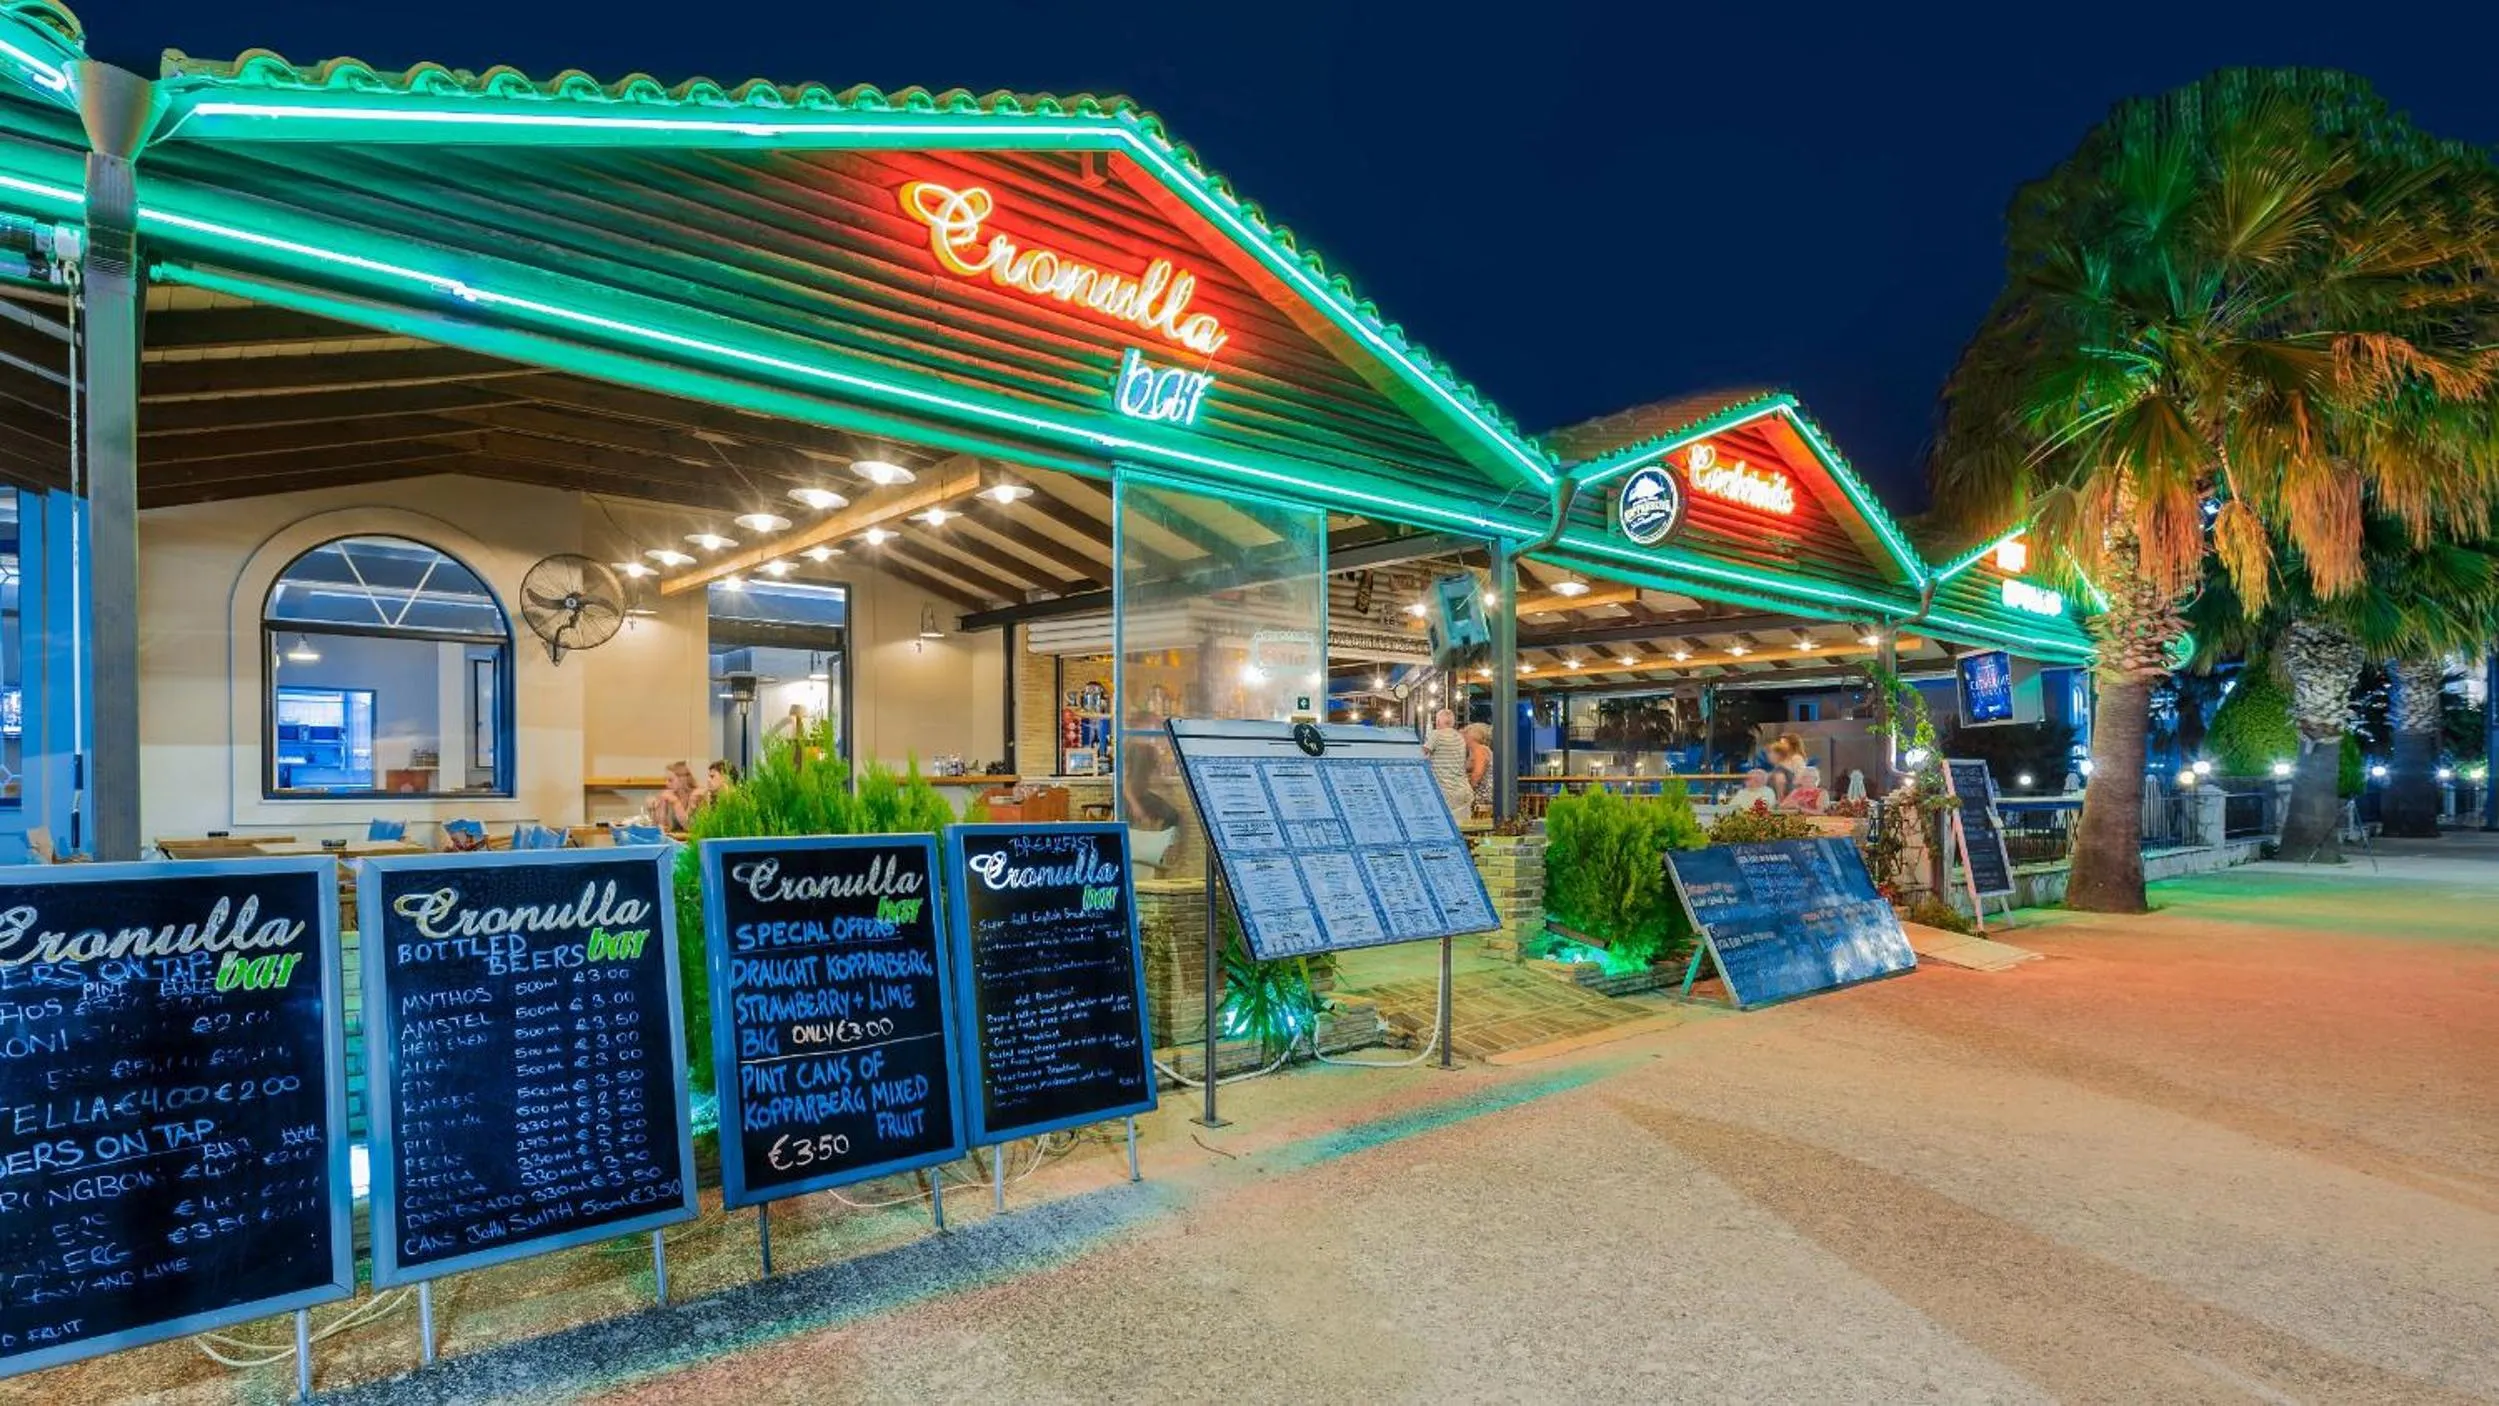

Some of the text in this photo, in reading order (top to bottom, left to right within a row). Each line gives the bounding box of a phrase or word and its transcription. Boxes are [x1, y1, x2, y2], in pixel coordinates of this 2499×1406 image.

[900, 180, 1229, 353] Cronulla
[1115, 347, 1214, 425] bar
[1009, 835, 1096, 857] BREAKFAST
[732, 854, 924, 902] Cronulla
[969, 850, 1121, 890] Cronulla
[393, 879, 652, 940] Cronulla
[876, 896, 924, 924] bar
[1083, 884, 1121, 911] bar
[0, 894, 306, 965] Cronulla
[586, 926, 651, 963] bar
[736, 921, 830, 950] SPECIAL
[99, 952, 148, 982] ON
[397, 932, 529, 965] BOTTLED
[484, 944, 587, 977] BEERS
[215, 951, 306, 993] bar
[730, 949, 934, 989] DRAUGHT KOPPARBERG
[82, 981, 128, 1001] PINT
[402, 986, 494, 1017] MYTHOS
[736, 985, 852, 1025] STRAWBERRY
[869, 981, 915, 1010] LIME
[401, 1011, 494, 1041] AMSTEL
[742, 1027, 781, 1058] BIG
[791, 1021, 835, 1045] ONLY
[741, 1050, 886, 1099] PINT CANS OF
[743, 1073, 929, 1133] KOPPARBERG MIXED
[875, 1108, 926, 1141] FRUIT
[96, 1129, 149, 1160] ON
[767, 1133, 850, 1172] €3.50
[465, 1220, 507, 1244] JOHN
